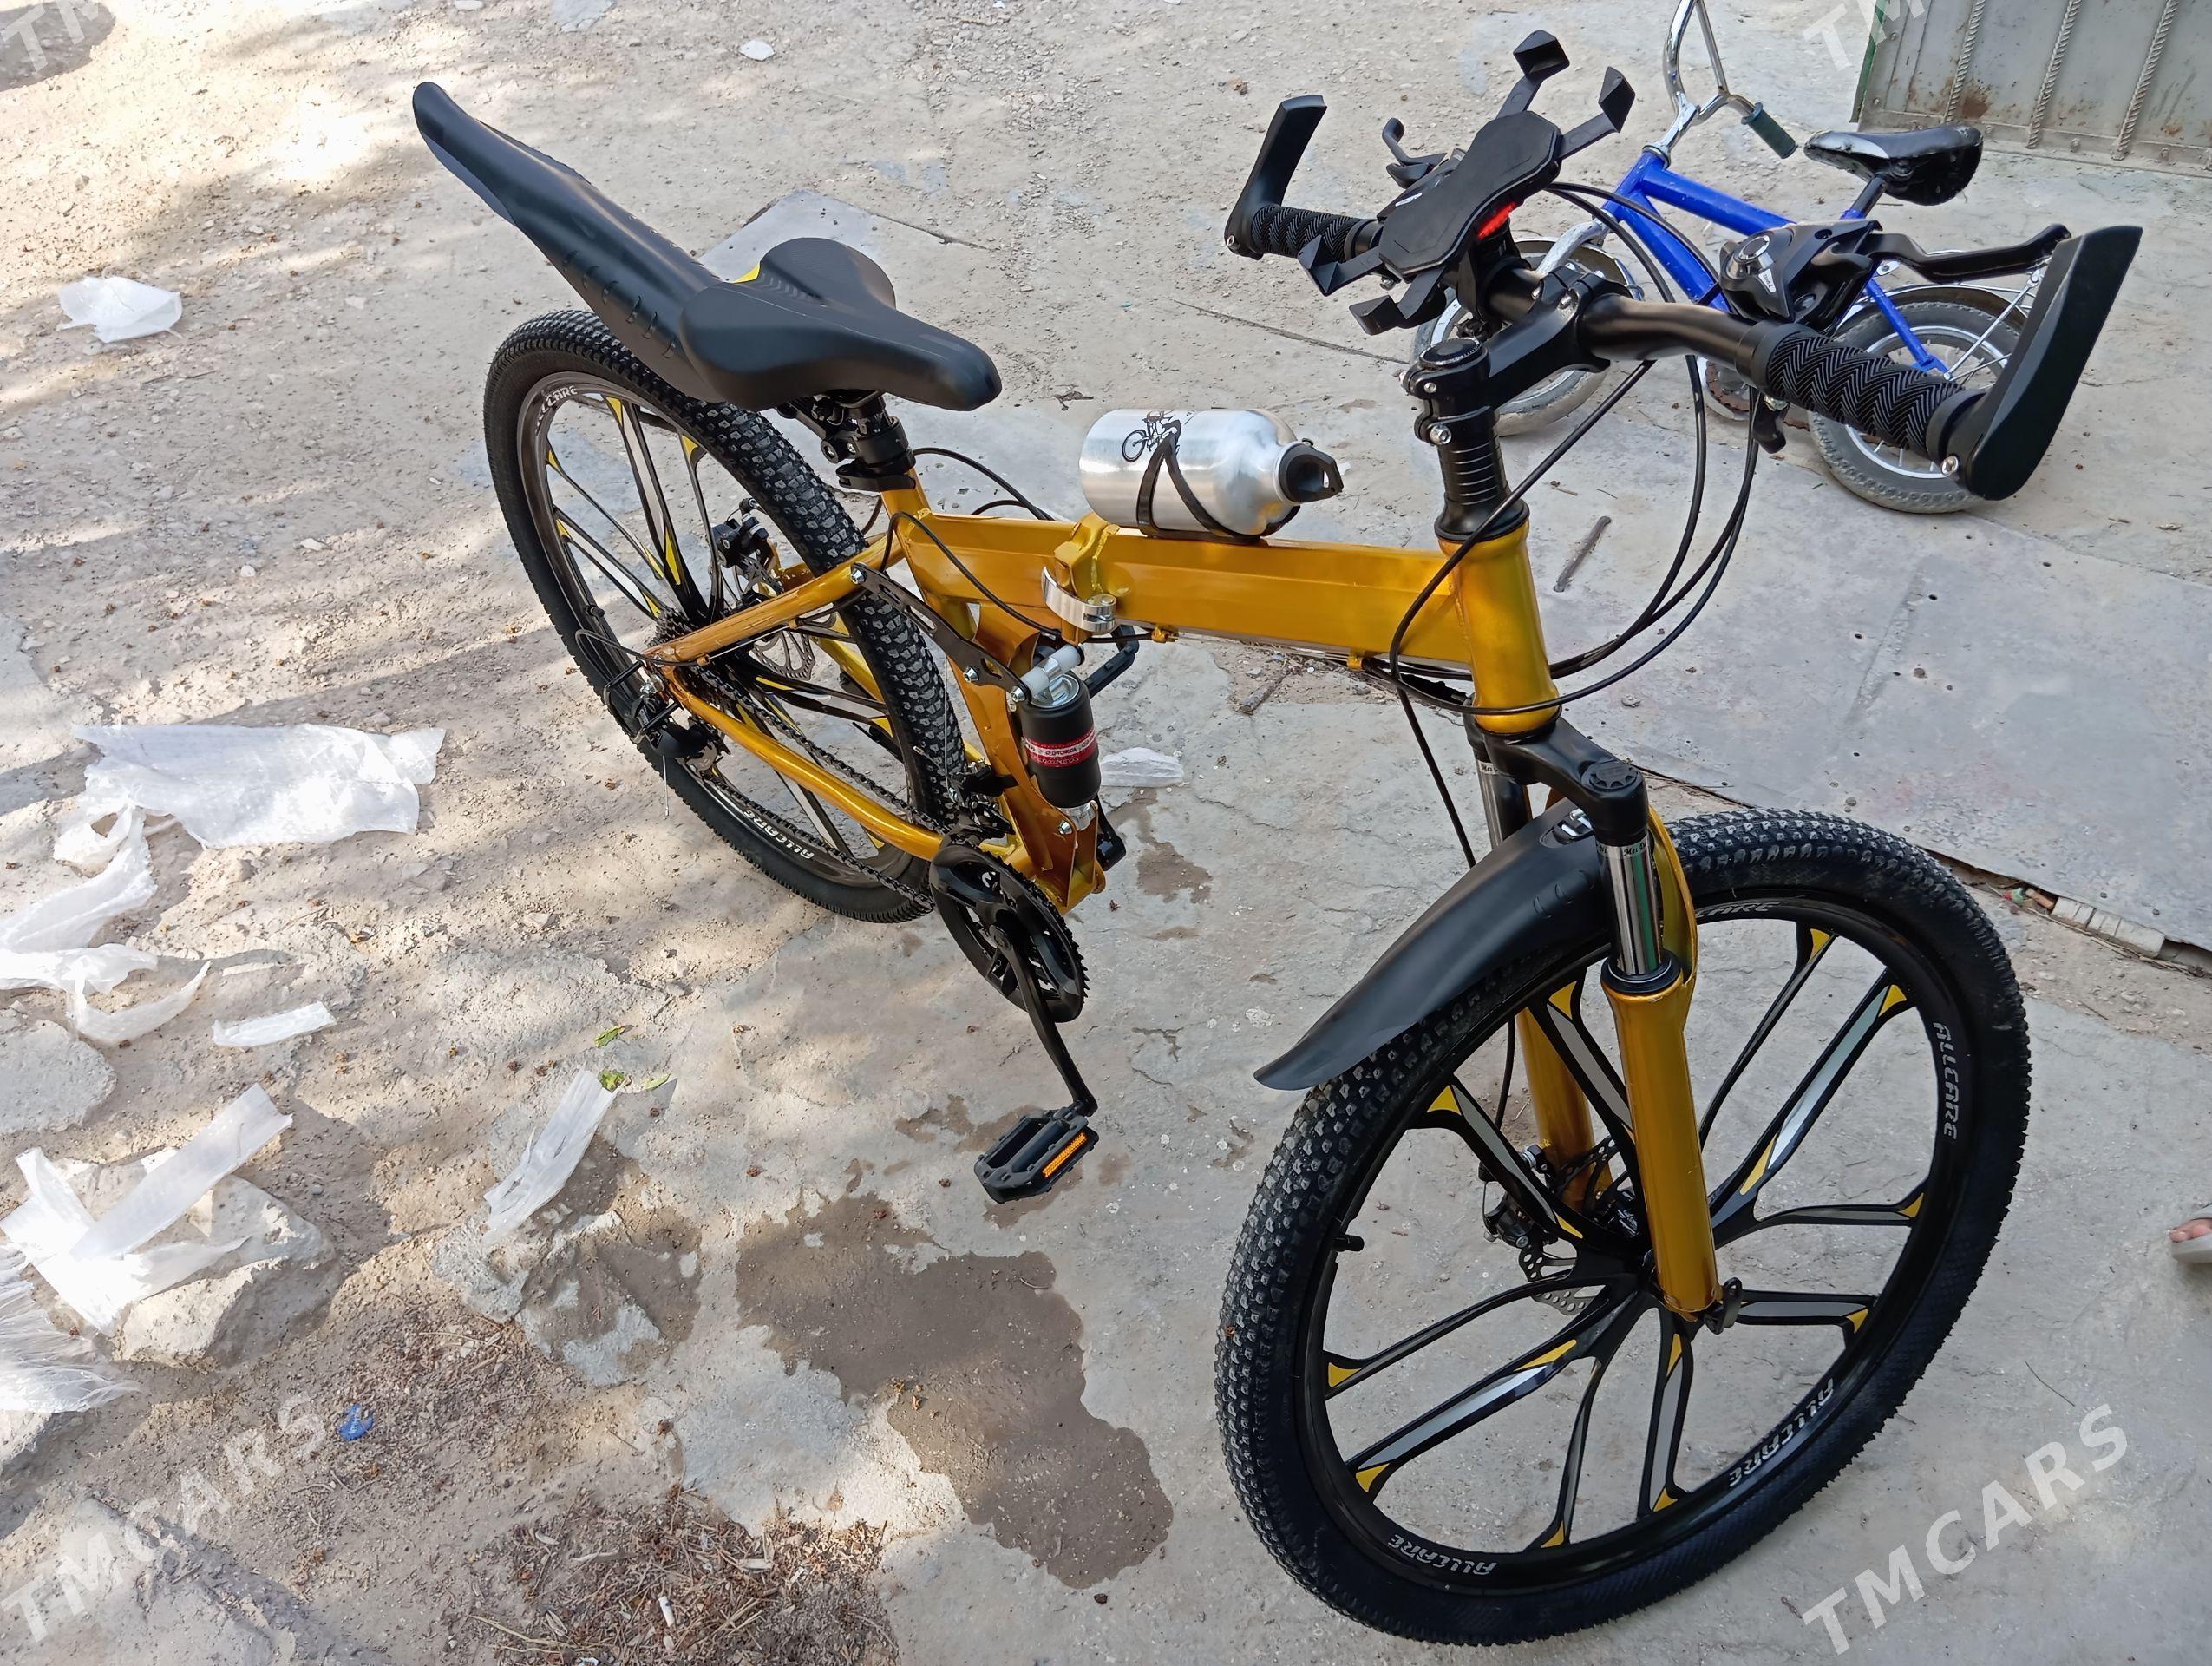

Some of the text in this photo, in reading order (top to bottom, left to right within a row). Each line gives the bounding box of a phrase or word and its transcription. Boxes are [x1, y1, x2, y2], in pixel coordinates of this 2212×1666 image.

[743, 809, 815, 860] ALLCARE
[1933, 1022, 1960, 1140] ALLCARE
[1729, 1377, 1834, 1487] ALLCARE
[1388, 1534, 1497, 1576] ALLCARE
